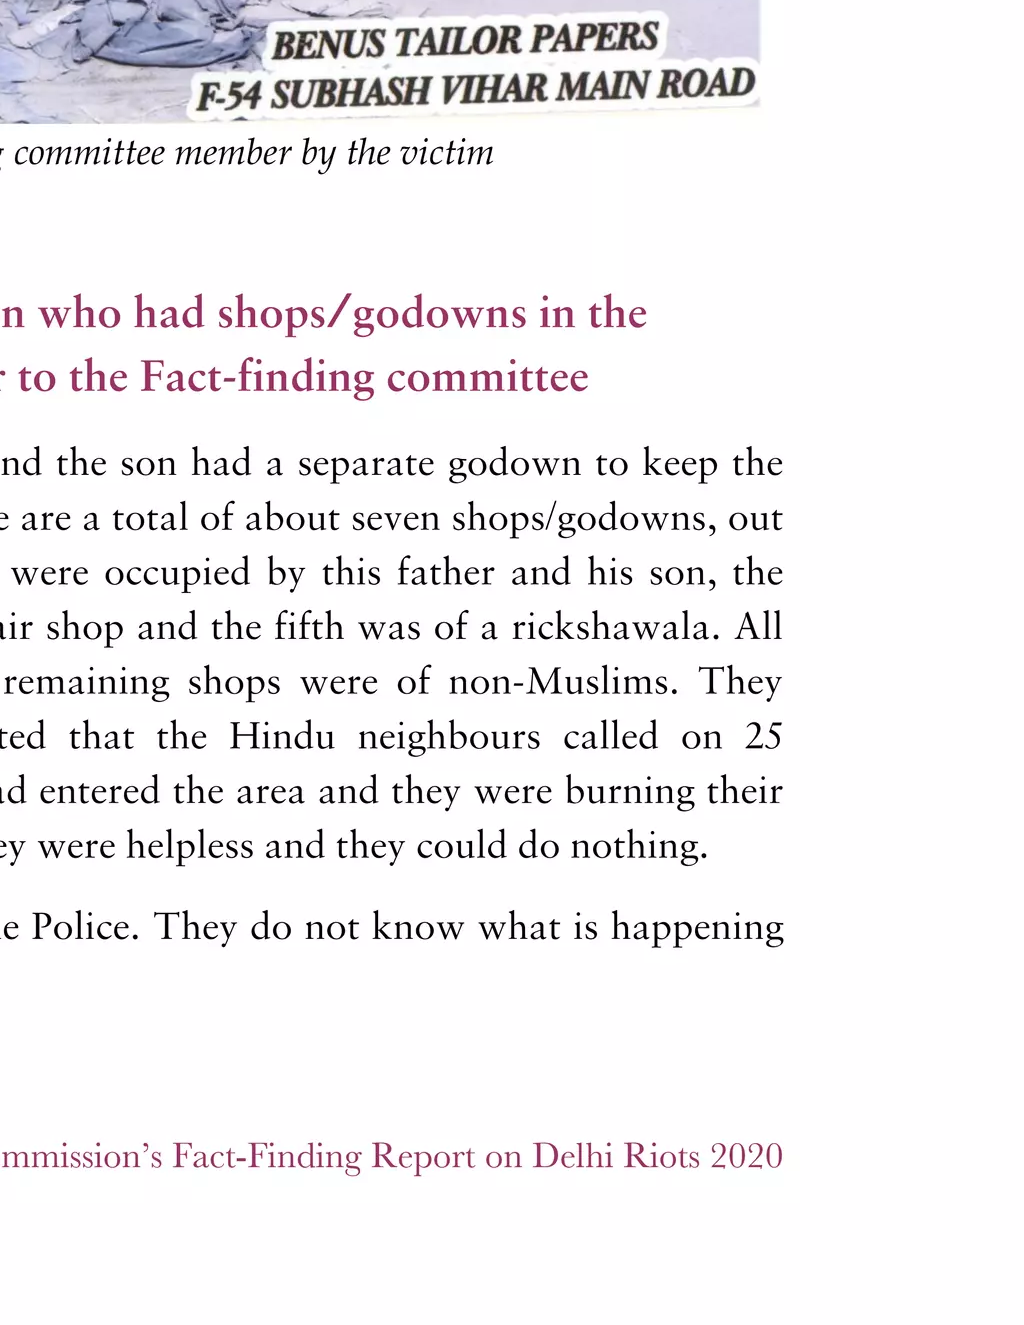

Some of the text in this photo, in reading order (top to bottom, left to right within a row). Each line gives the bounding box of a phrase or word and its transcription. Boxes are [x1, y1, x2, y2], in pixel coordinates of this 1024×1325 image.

[14, 137, 166, 166] committee
[175, 136, 293, 166] member
[301, 136, 337, 175] by
[347, 136, 391, 166] the
[399, 137, 494, 166] victim
[37, 293, 121, 329] who
[134, 292, 205, 329] had
[218, 292, 527, 338] shops/godowns
[539, 294, 576, 328] in
[588, 292, 647, 329] the
[18, 366, 56, 392] to
[69, 356, 128, 392] the
[140, 356, 375, 402] Fact-finding
[387, 358, 589, 393] committee
[172, 1142, 363, 1177] Fact-Finding
[371, 1141, 476, 1177] Report
[485, 1151, 523, 1169] on
[532, 1142, 614, 1169] Delhi
[623, 1142, 700, 1169] Riots
[711, 1142, 783, 1170] 2020
